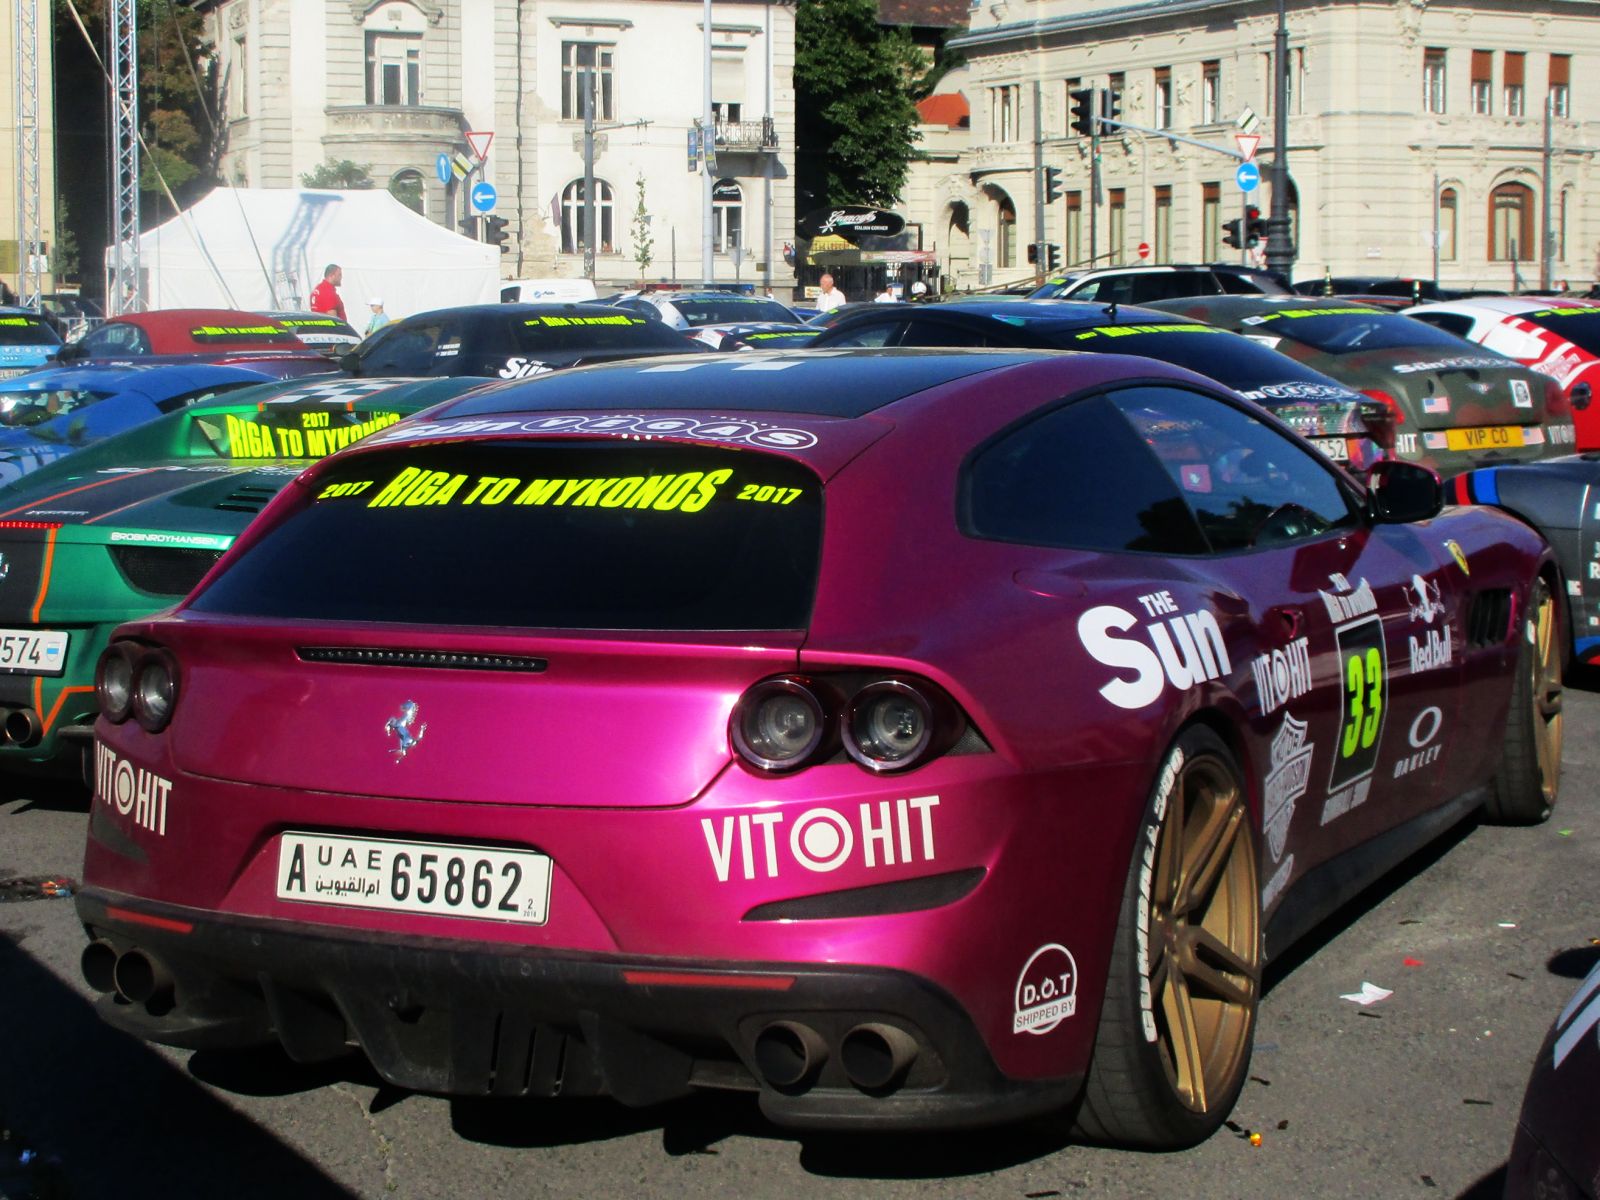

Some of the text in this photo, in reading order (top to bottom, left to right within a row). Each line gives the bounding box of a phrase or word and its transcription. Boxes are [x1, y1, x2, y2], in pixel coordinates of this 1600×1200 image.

[226, 414, 276, 458] RIGA
[277, 428, 304, 457] TO
[302, 412, 329, 428] 2017
[1465, 430, 1486, 445] VIP
[317, 466, 804, 513] 2017 RIGA TO MYKONOS 2017
[1137, 590, 1178, 618] THE
[0, 636, 40, 665] 574
[1077, 605, 1232, 709] Sun
[1342, 647, 1383, 759] 33
[286, 844, 306, 893] A
[391, 852, 523, 912] 65862
[1023, 973, 1071, 1006] D.O.T
[1016, 1000, 1074, 1028] SHIPPED BY
